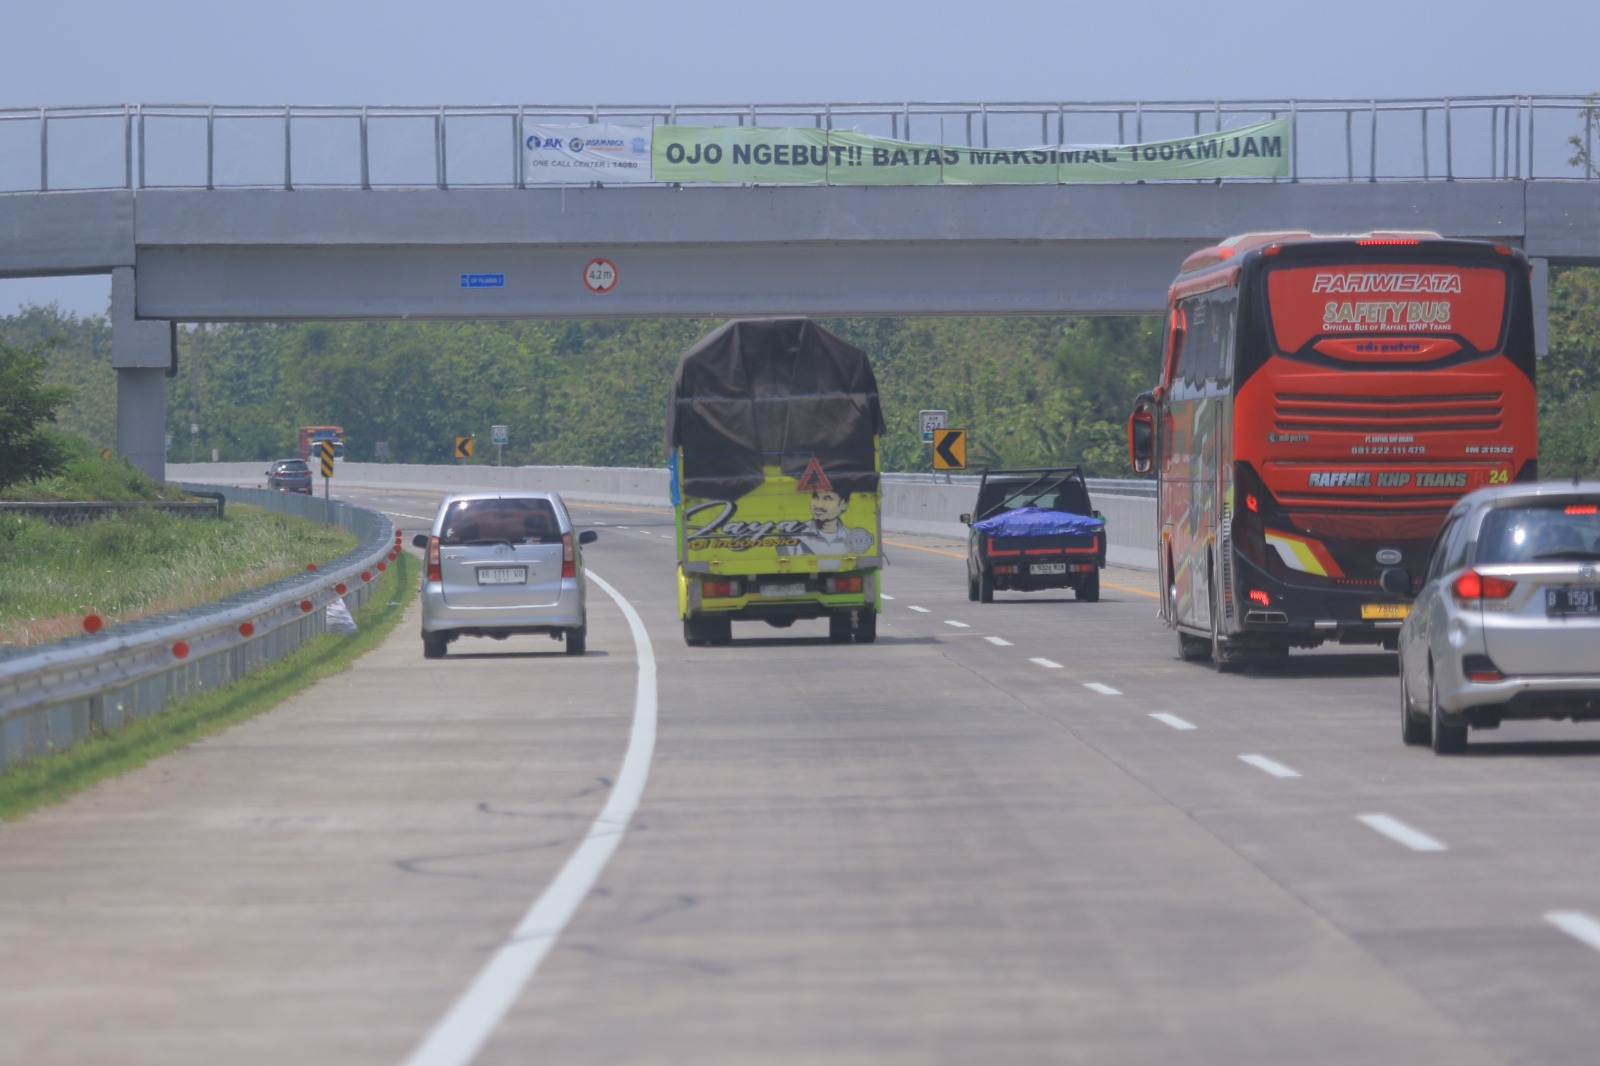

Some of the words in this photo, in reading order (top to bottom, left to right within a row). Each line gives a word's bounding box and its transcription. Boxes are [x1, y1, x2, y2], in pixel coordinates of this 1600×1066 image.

[666, 143, 723, 165] OJO
[732, 143, 862, 166] NGEBUT!!
[872, 147, 960, 167] BATAS
[969, 150, 1117, 165] MAKSIMAL
[551, 160, 571, 168] CALL
[574, 160, 605, 168] CENTER
[589, 270, 602, 279] 4.2
[1312, 273, 1462, 294] PARIWISATA
[1322, 301, 1406, 323] SAFETY
[1406, 302, 1451, 322] BUS
[1308, 472, 1372, 487] RAFFAEL
[1376, 472, 1410, 487] KNP
[1414, 472, 1467, 487] TRANS
[1489, 470, 1508, 484] 24
[1548, 592, 1556, 607] B
[1568, 591, 1595, 607] 1591
